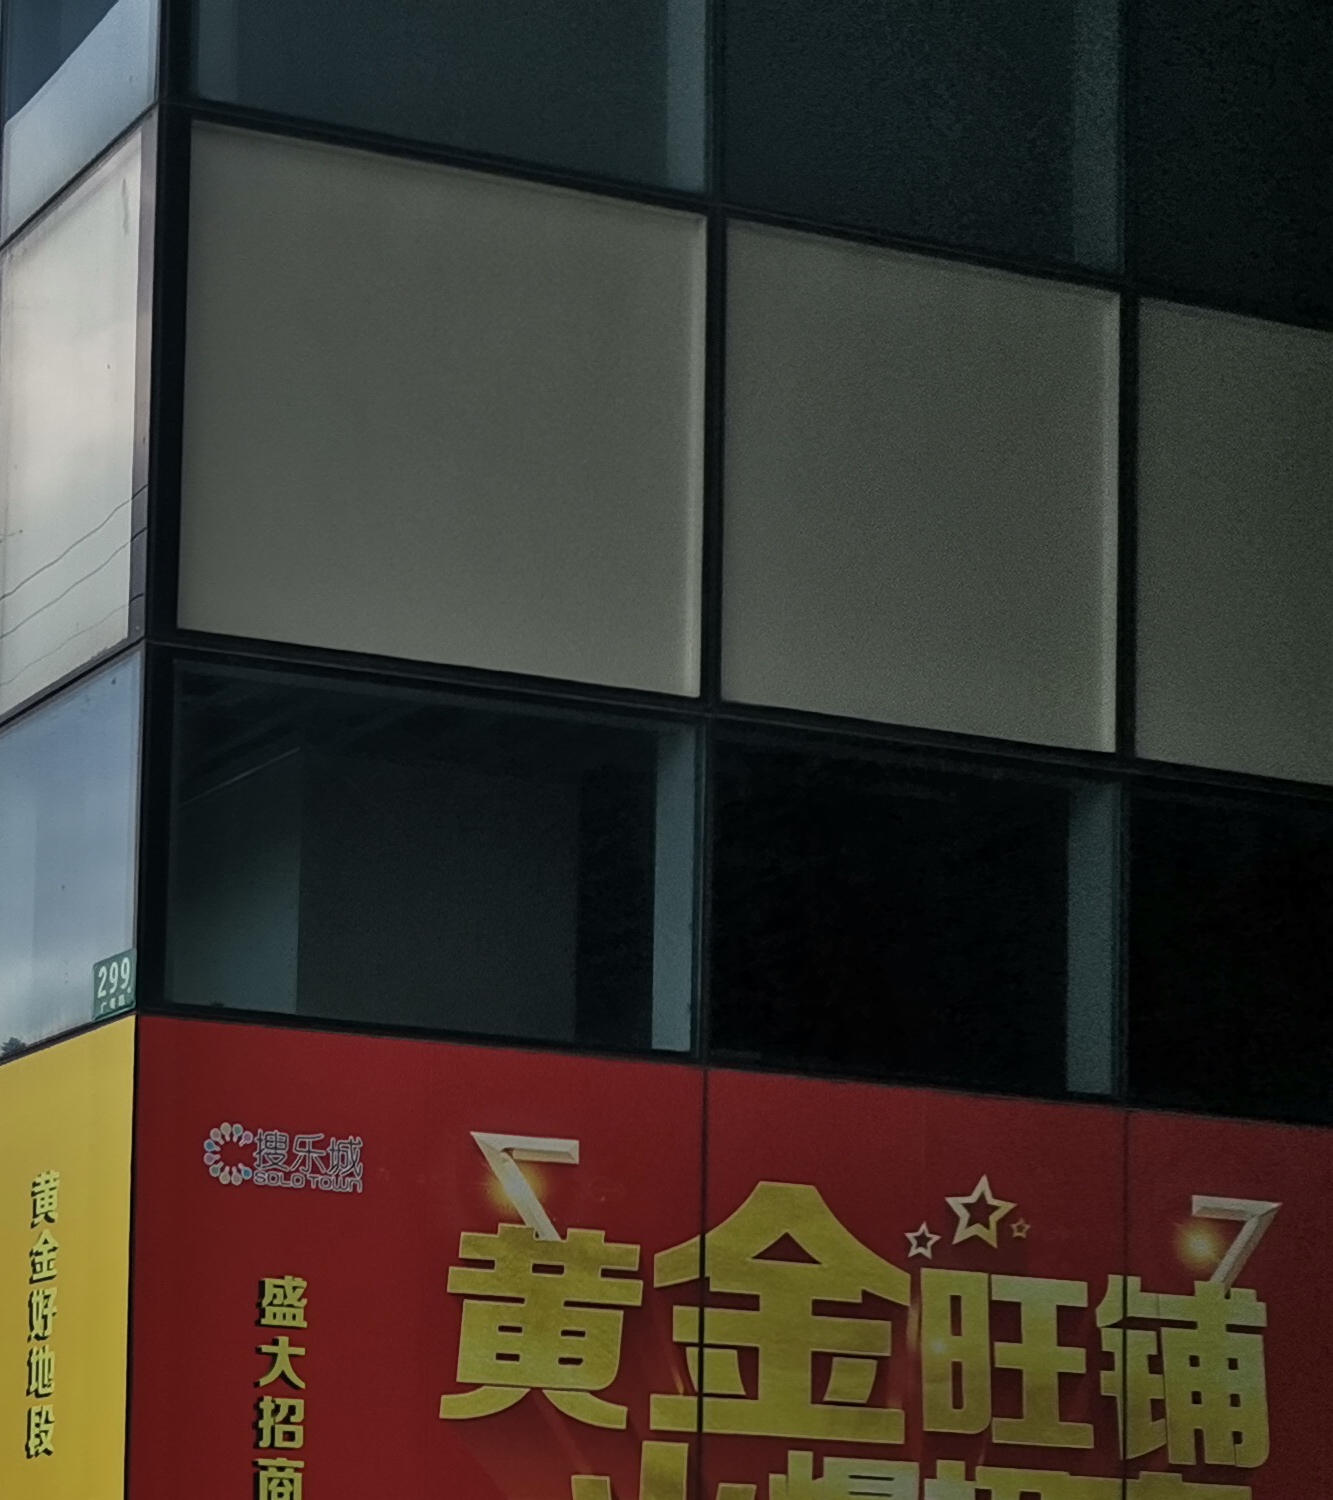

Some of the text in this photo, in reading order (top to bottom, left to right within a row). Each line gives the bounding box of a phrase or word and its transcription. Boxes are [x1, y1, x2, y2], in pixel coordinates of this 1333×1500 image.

[253, 1129, 363, 1178] 搜乐城
[254, 1171, 305, 1188] SOLO
[26, 1170, 61, 1458] 黄金好地段
[439, 1181, 1271, 1467] 黄金旺铺
